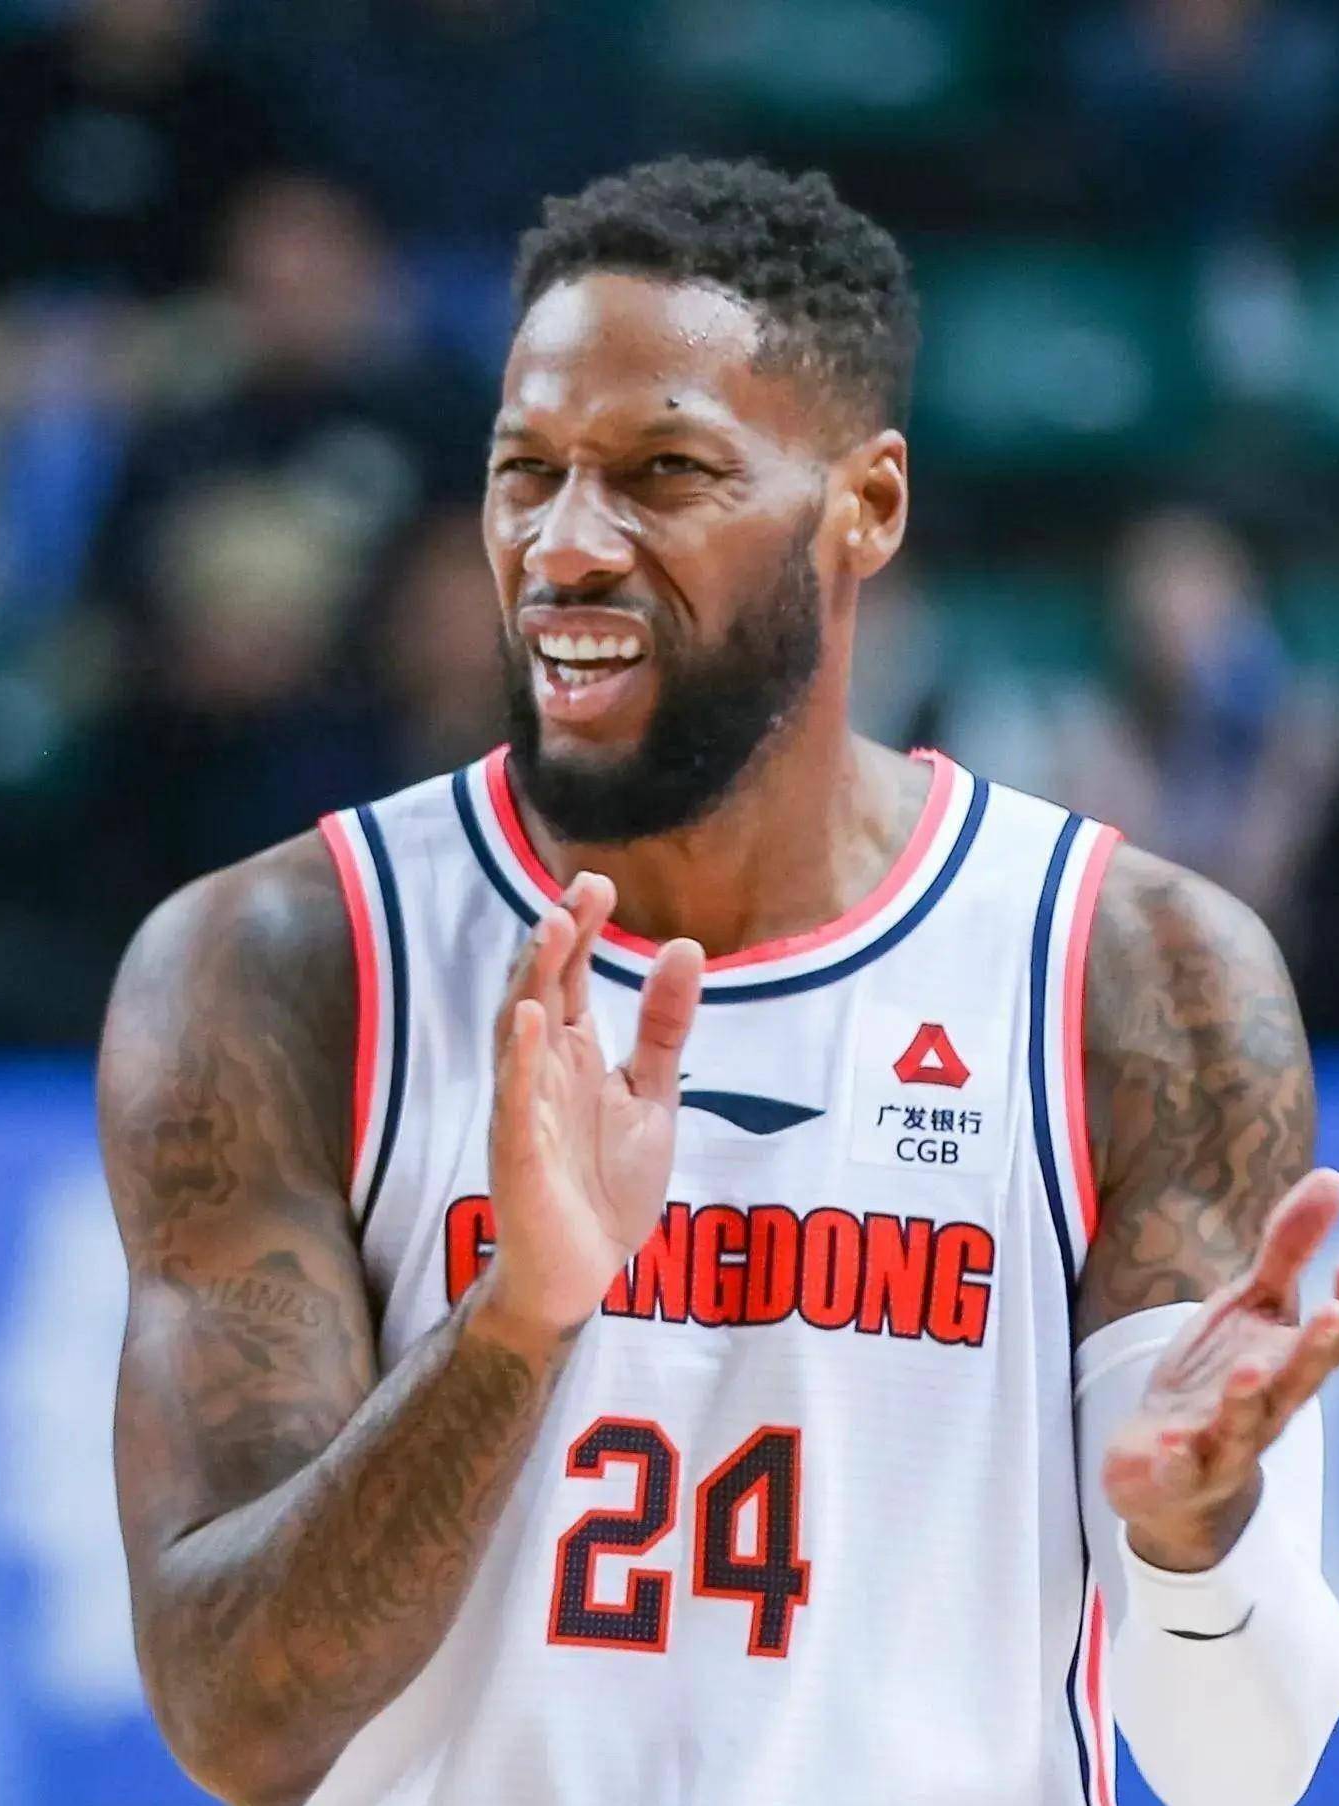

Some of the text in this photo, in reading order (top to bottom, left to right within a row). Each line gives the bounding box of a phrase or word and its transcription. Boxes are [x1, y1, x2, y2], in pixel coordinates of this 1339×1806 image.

[876, 1104, 982, 1134] 广发银行
[896, 1137, 959, 1164] CGB
[546, 1415, 812, 1659] 24
